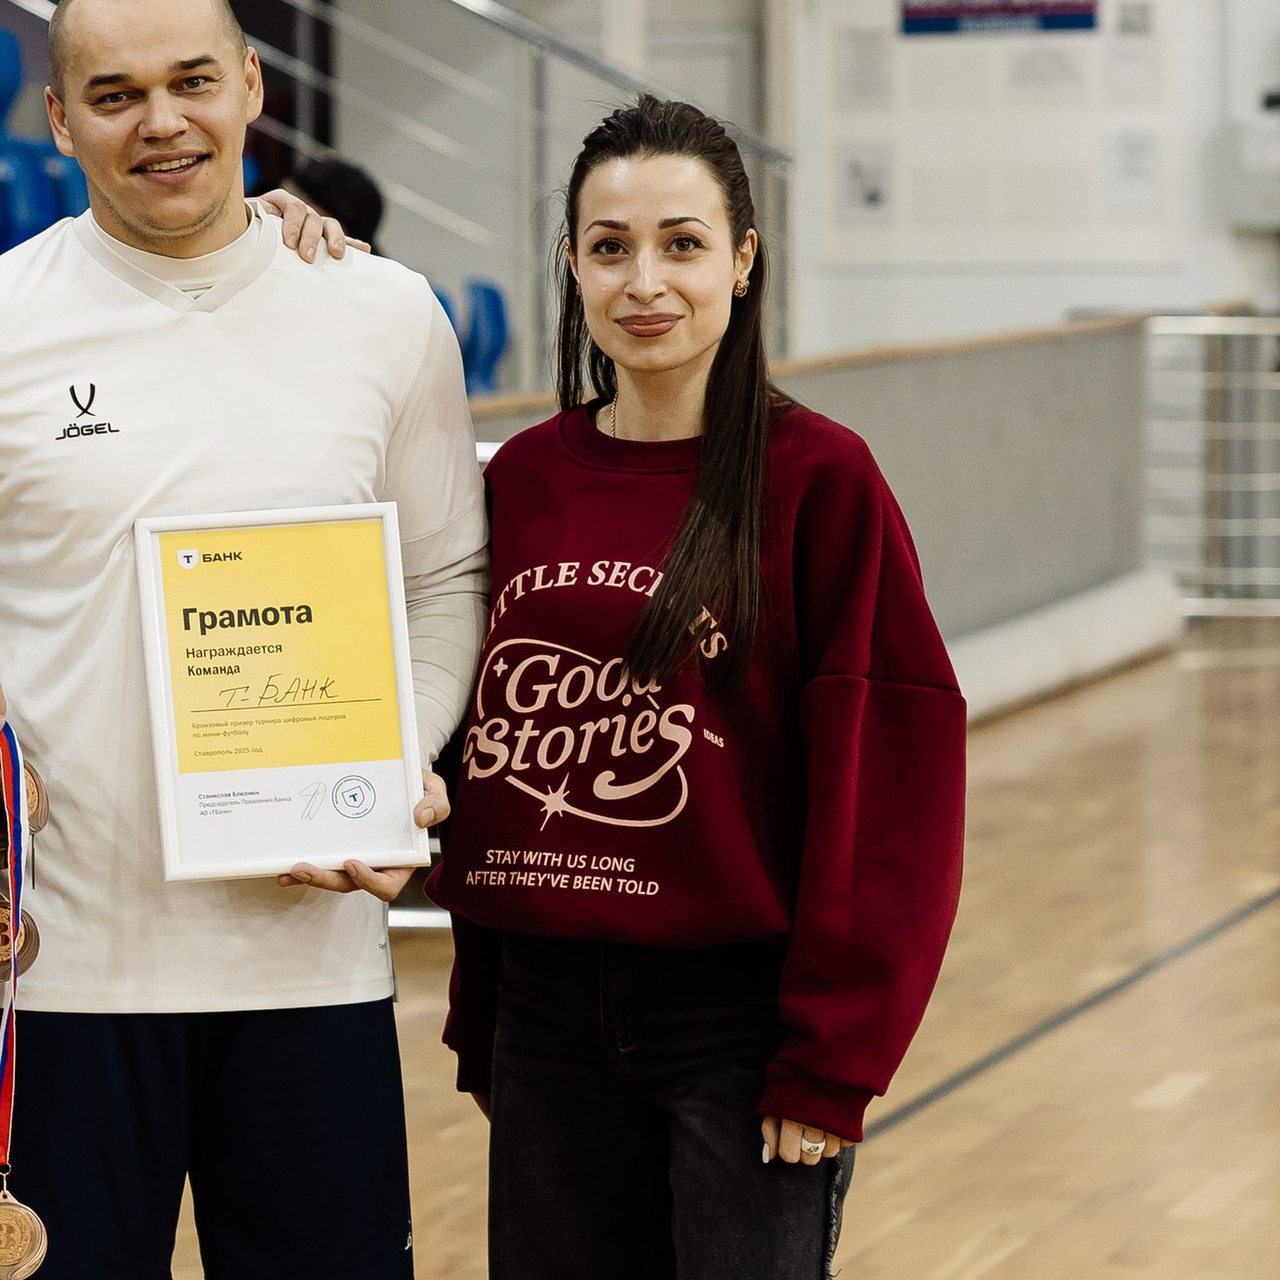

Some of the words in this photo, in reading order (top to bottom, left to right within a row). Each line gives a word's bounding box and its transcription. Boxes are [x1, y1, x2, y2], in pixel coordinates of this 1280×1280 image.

[55, 423, 120, 440] JÖGEL
[202, 551, 243, 563] БАНК
[483, 562, 580, 650] ITTLE
[587, 560, 728, 659] SECTS
[182, 604, 313, 636] Грамота
[185, 643, 283, 660] Награждается
[187, 664, 241, 677] Команда
[191, 721, 229, 730] Бронзовый
[255, 718, 281, 726] турнира
[282, 715, 317, 724] цифровых
[318, 713, 347, 721] лидеров
[202, 729, 250, 738] мини-футболу
[703, 728, 724, 748] IDEAS
[194, 749, 233, 757] Ставрополь
[234, 747, 250, 755] 2025
[251, 746, 263, 754] год
[198, 792, 231, 800] Станислав
[199, 800, 240, 808] Председатель
[486, 849, 521, 865] STAY
[523, 850, 563, 867] WITH
[567, 854, 587, 869] US
[590, 855, 635, 872] LONG
[466, 870, 506, 885] AFTER
[509, 871, 570, 889] THEY'VE
[573, 875, 612, 891] BEEN
[616, 878, 659, 895] TOLD
